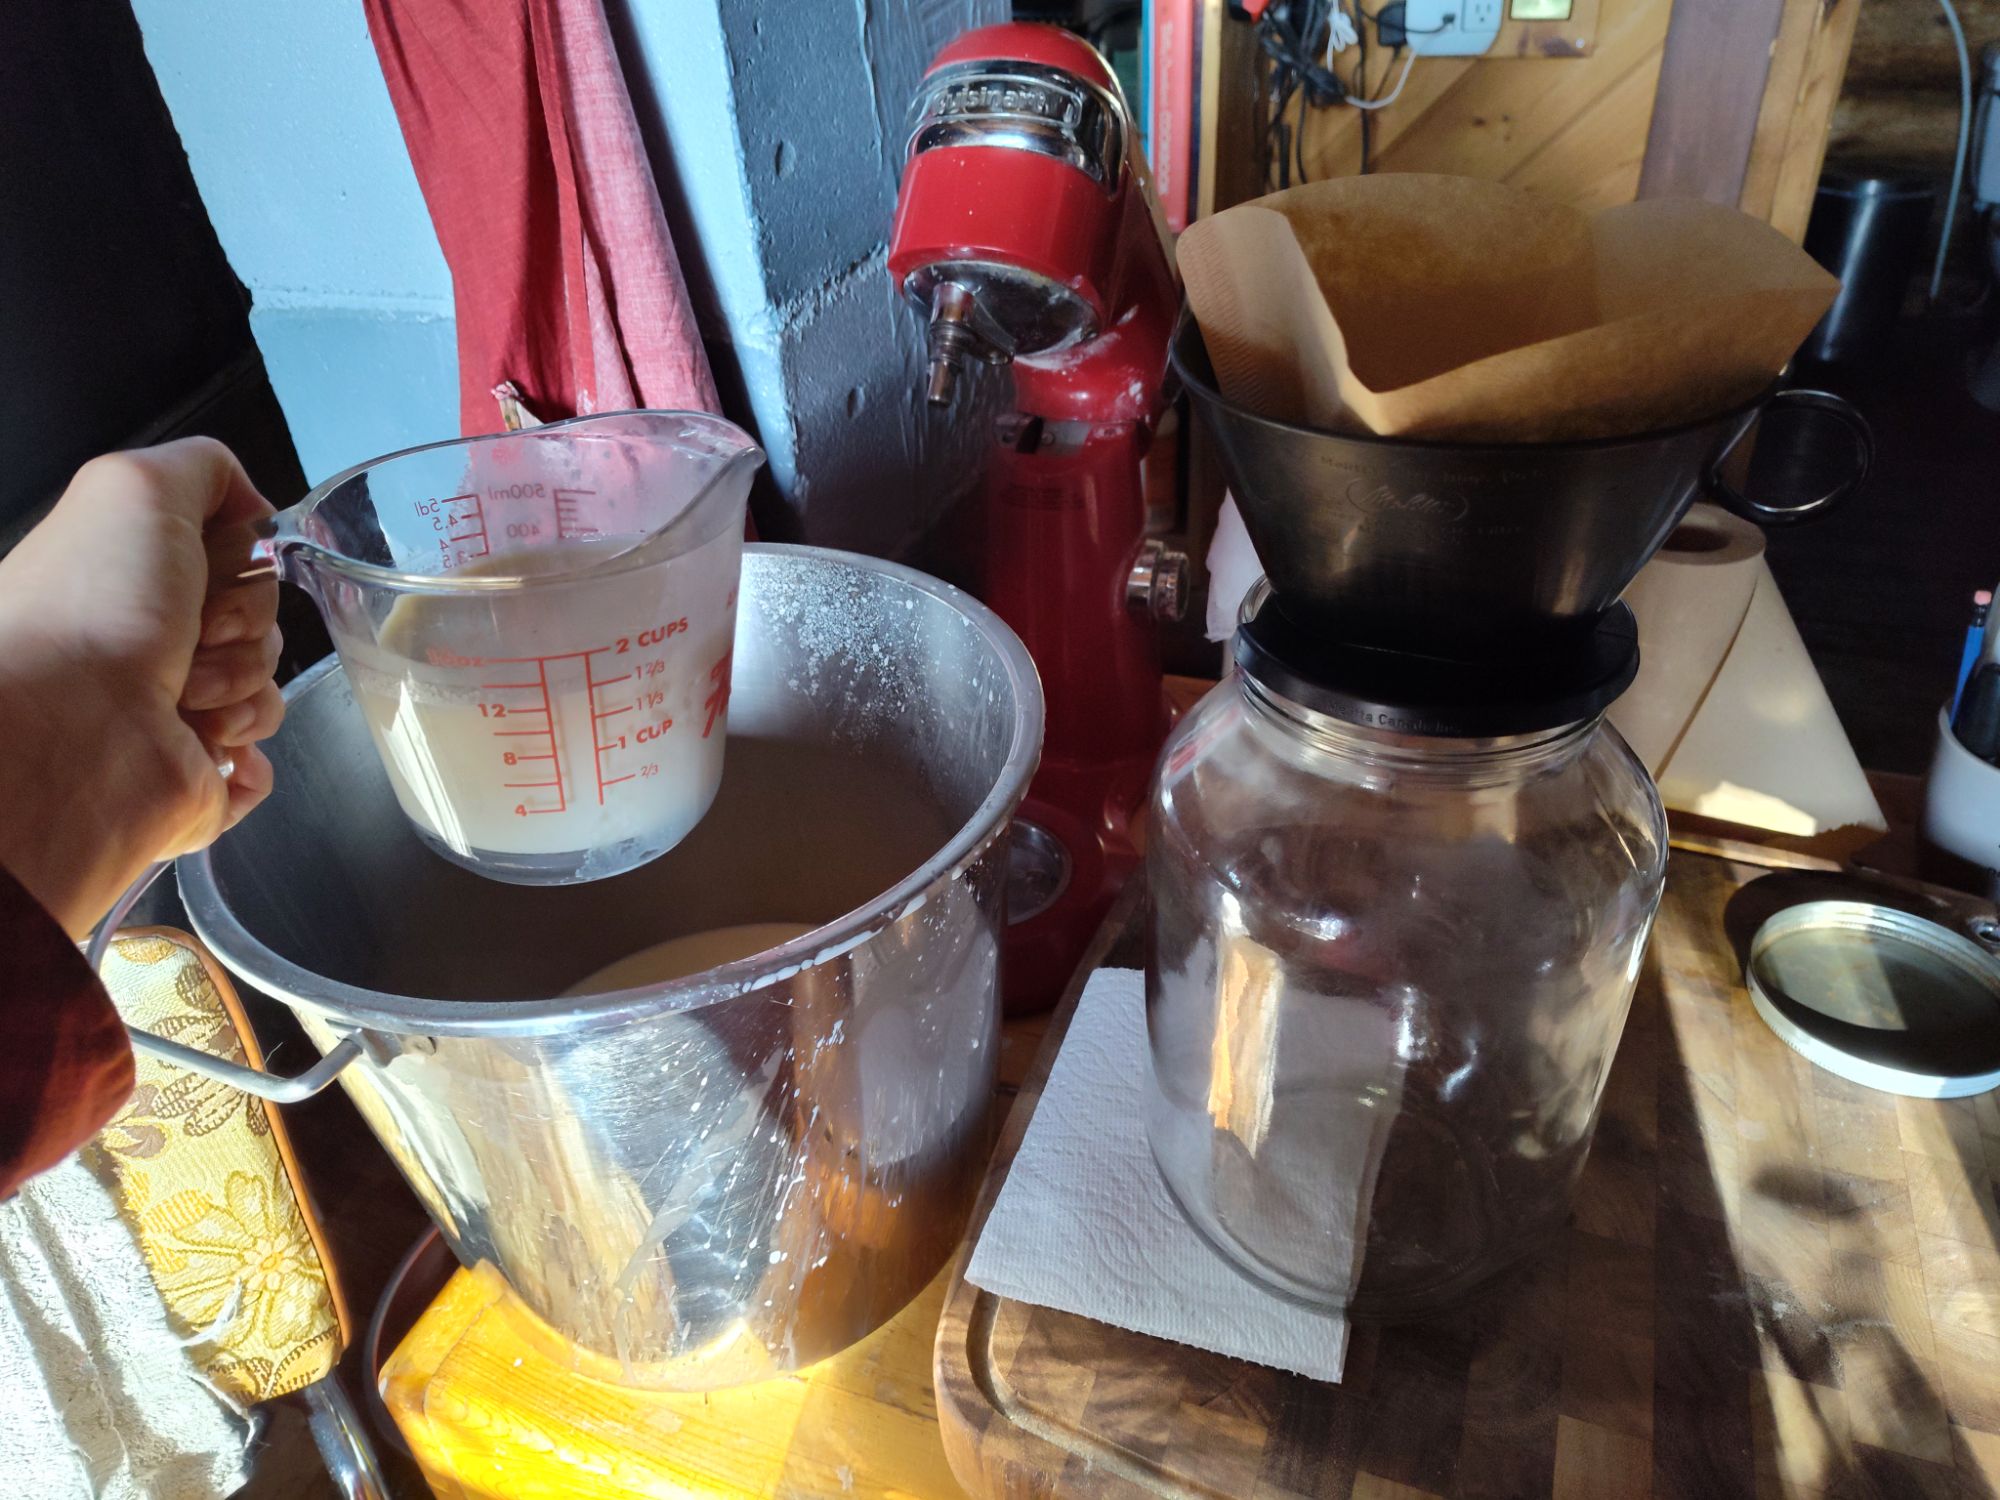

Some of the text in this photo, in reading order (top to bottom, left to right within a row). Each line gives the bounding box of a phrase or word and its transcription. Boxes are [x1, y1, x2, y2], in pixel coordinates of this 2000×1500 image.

[615, 616, 689, 655] 2 CUPS
[478, 703, 507, 719] 12
[617, 719, 674, 749] 1 CUP
[503, 751, 518, 767] 8
[641, 763, 659, 778] 2/3
[513, 804, 528, 817] 4
